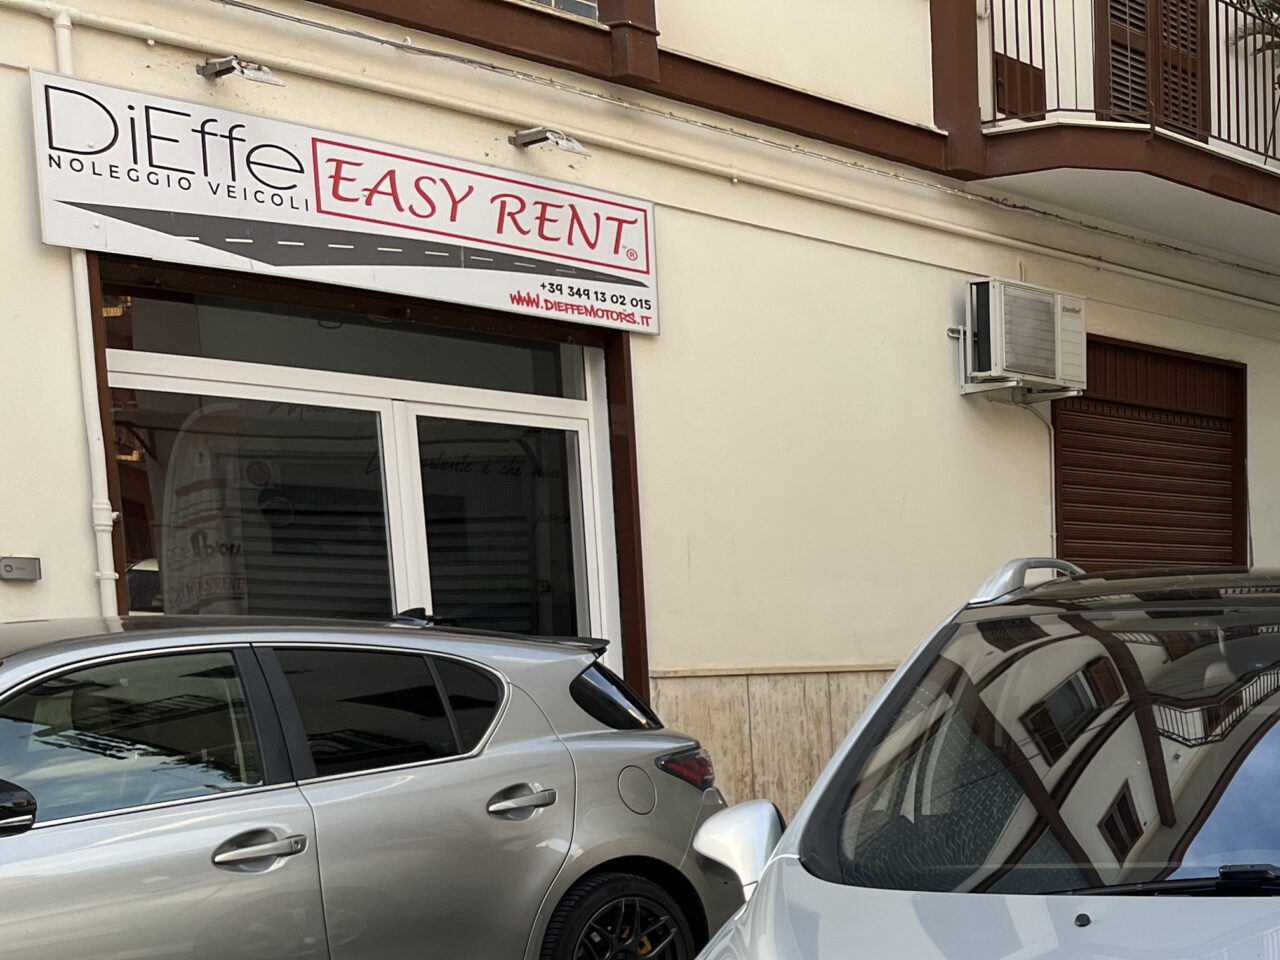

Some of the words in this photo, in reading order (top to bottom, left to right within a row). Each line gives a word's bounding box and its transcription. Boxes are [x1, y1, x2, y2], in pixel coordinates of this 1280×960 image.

[44, 85, 305, 191] DiEffe
[48, 154, 192, 191] NOLEGGIO
[208, 181, 310, 212] VEICOLI
[325, 158, 474, 222] EASY
[509, 290, 652, 327] WWW.DIEFFEMOTORS.IT
[540, 281, 563, 295] +39
[567, 286, 590, 300] 349
[594, 291, 607, 303] 13
[610, 294, 626, 306] 02
[630, 298, 652, 310] 015
